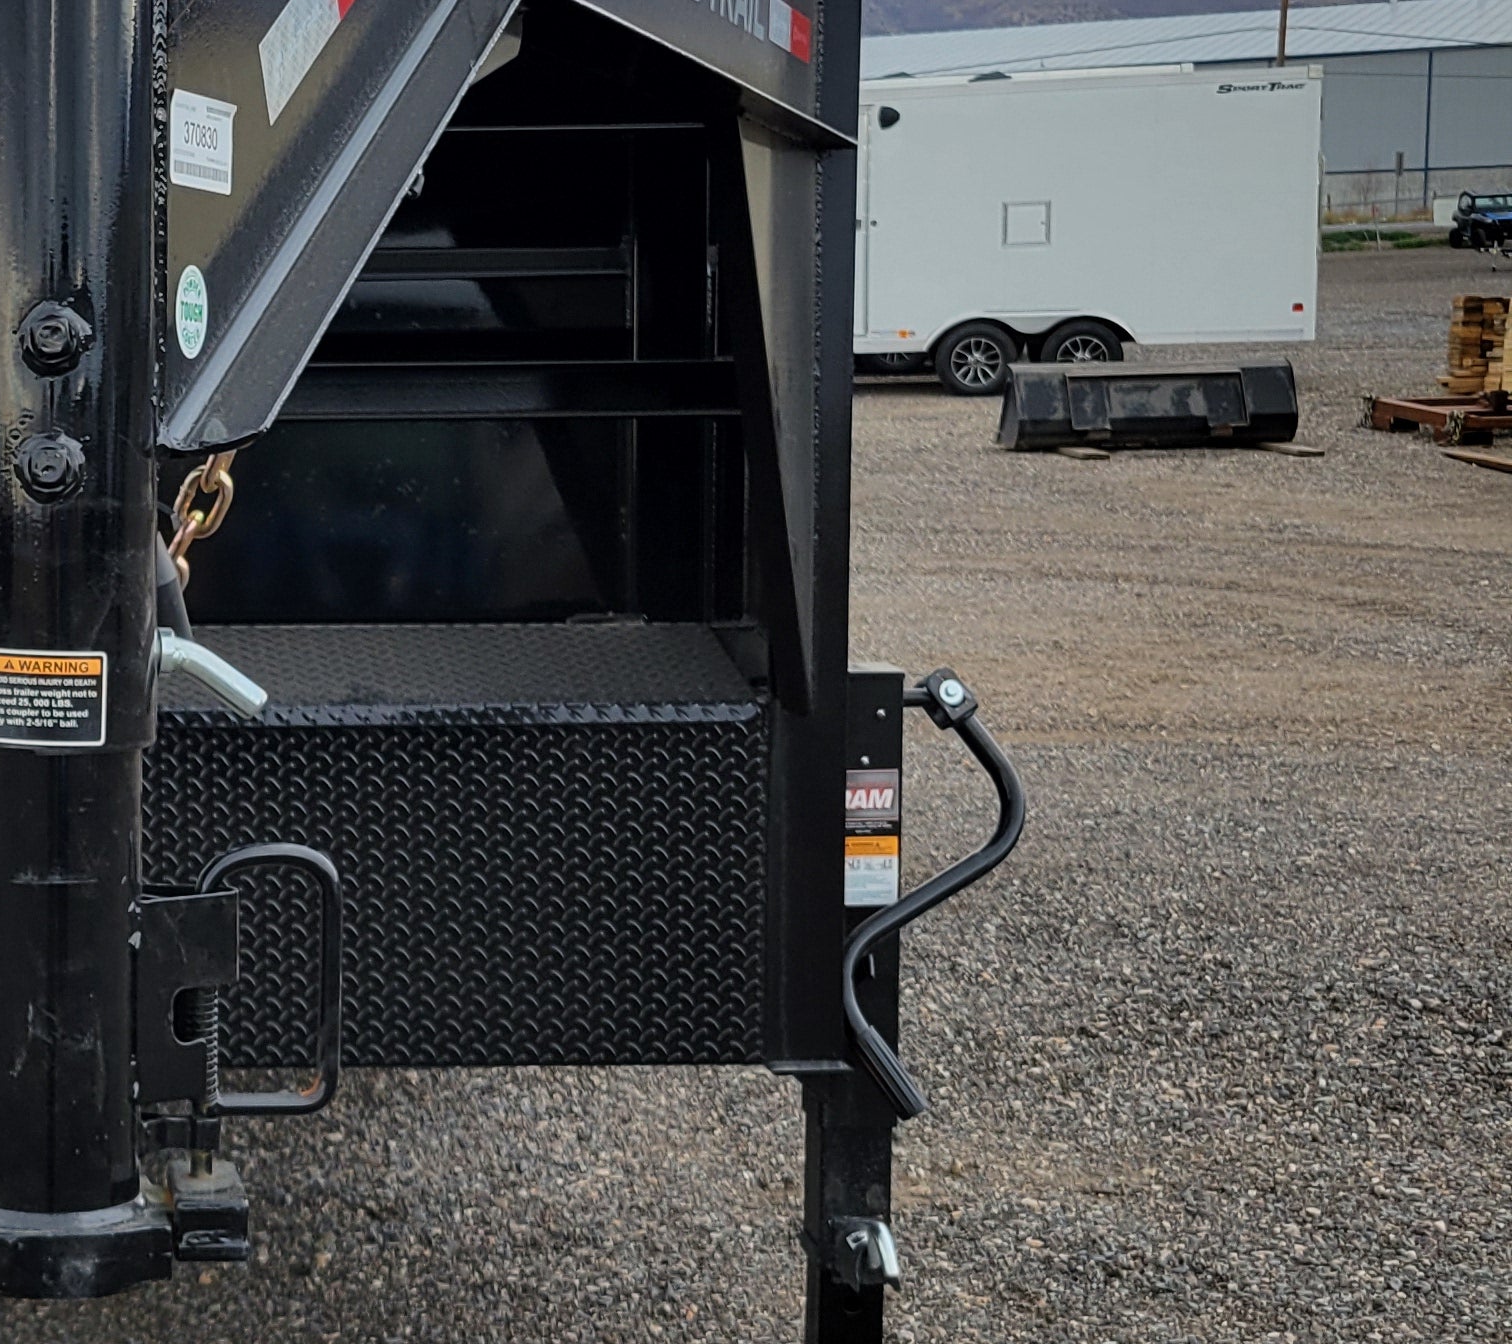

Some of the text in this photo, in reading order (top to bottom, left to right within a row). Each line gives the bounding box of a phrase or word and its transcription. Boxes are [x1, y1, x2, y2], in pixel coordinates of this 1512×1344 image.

[183, 120, 218, 151] 370830
[18, 659, 89, 673] WARNING
[8, 676, 37, 686] SERIOUS
[38, 678, 62, 687] INJURY
[63, 679, 73, 687] OR
[74, 678, 97, 687] DEATH
[13, 687, 39, 697] trailer
[40, 688, 70, 699] weight
[72, 690, 86, 698] not
[87, 690, 98, 698] to
[33, 699, 50, 707] 000
[51, 699, 73, 708] LBS.
[6, 707, 39, 718] coupler
[41, 709, 51, 717] to
[52, 709, 65, 717] be
[66, 709, 89, 718] used
[6, 717, 25, 726] with
[59, 719, 79, 728] ball.
